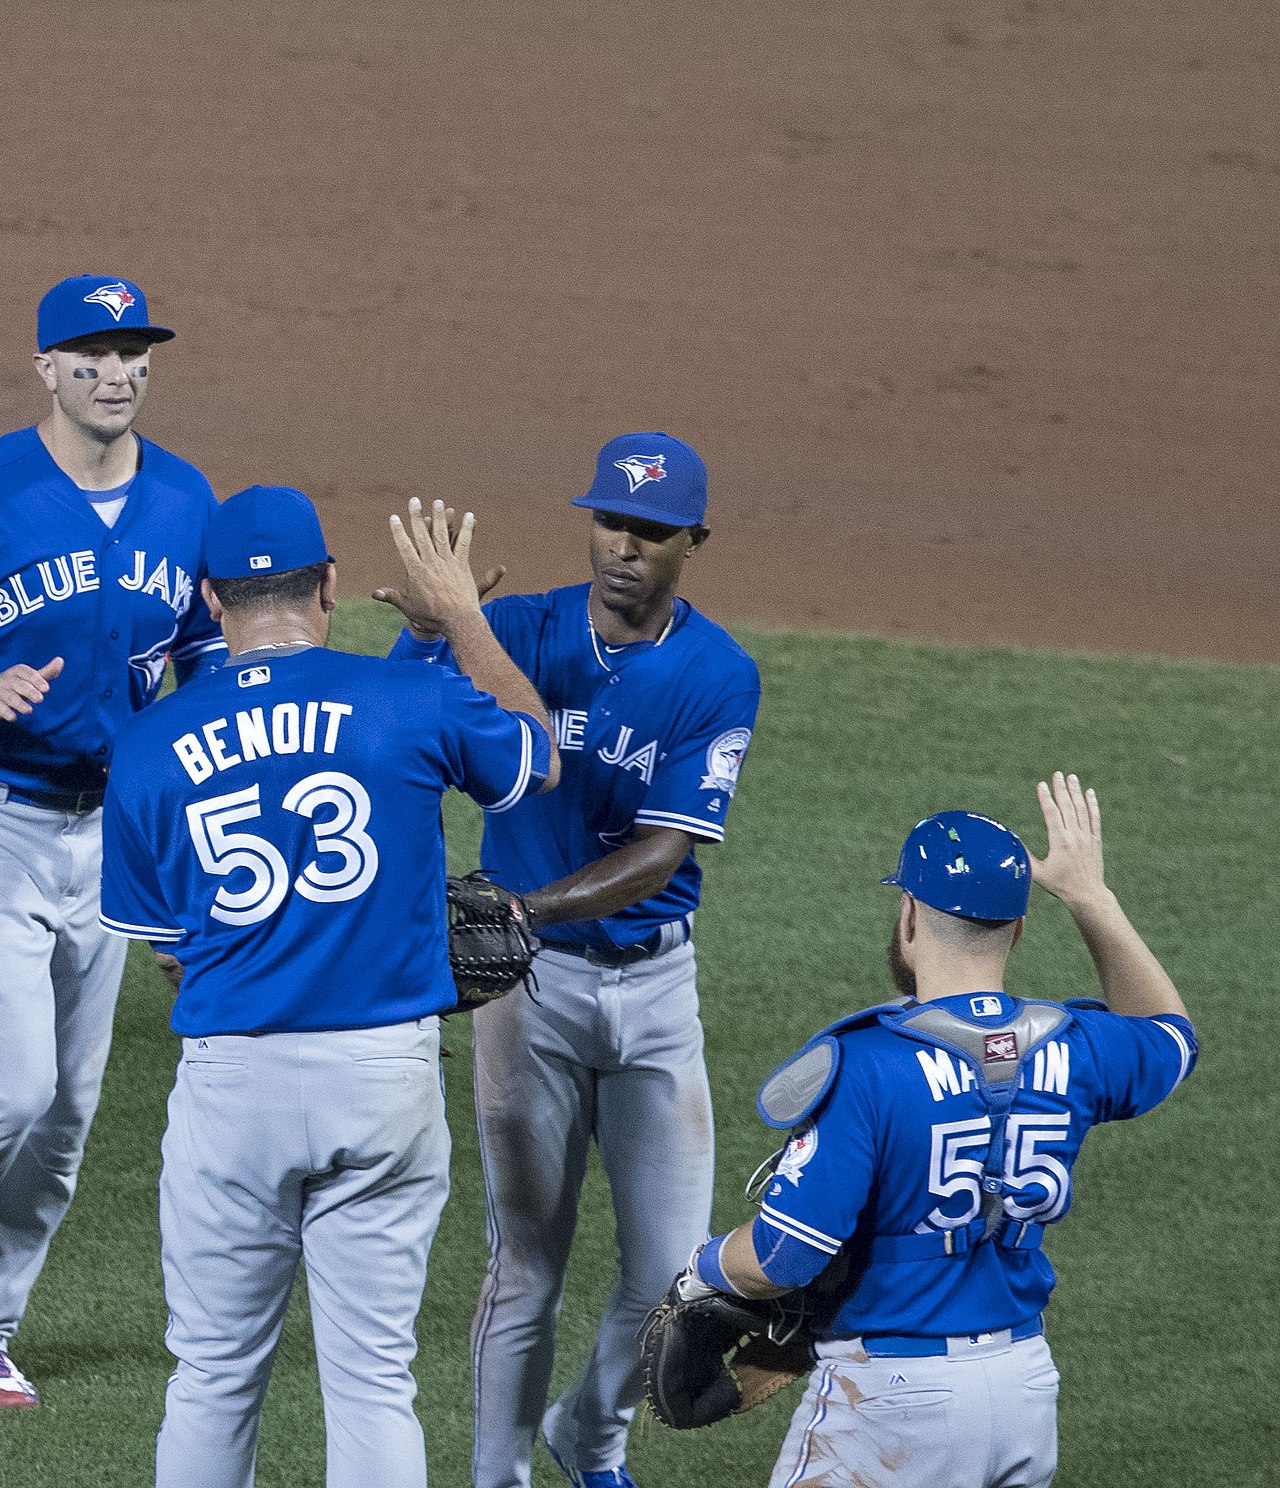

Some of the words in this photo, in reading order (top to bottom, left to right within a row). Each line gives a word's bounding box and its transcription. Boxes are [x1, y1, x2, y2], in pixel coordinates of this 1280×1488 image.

[172, 701, 353, 785] BENOIT
[597, 725, 667, 787] JA
[185, 771, 378, 926] 53
[915, 1040, 1069, 1102] MAIN
[914, 1111, 1071, 1234] 55
